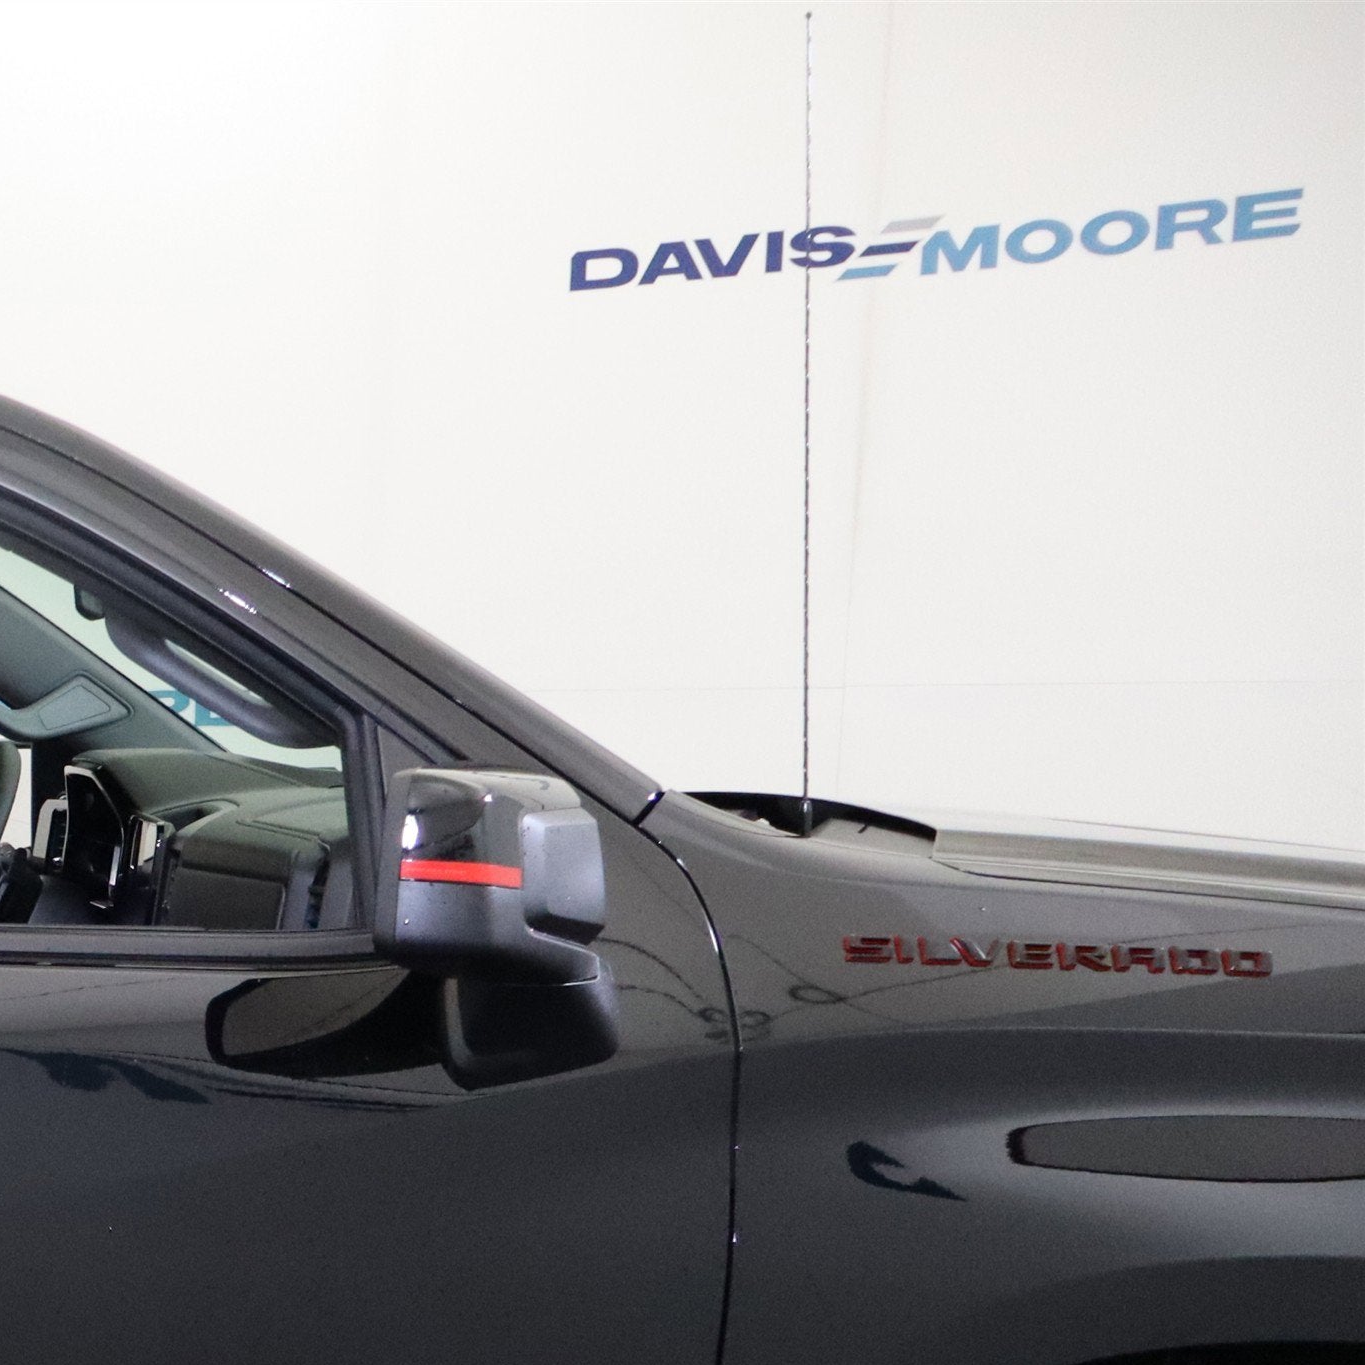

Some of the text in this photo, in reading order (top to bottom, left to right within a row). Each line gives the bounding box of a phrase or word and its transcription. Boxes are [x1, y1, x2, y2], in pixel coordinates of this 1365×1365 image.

[569, 187, 1304, 292] DAVIS MOORE
[842, 934, 1273, 978] SILVERADO
